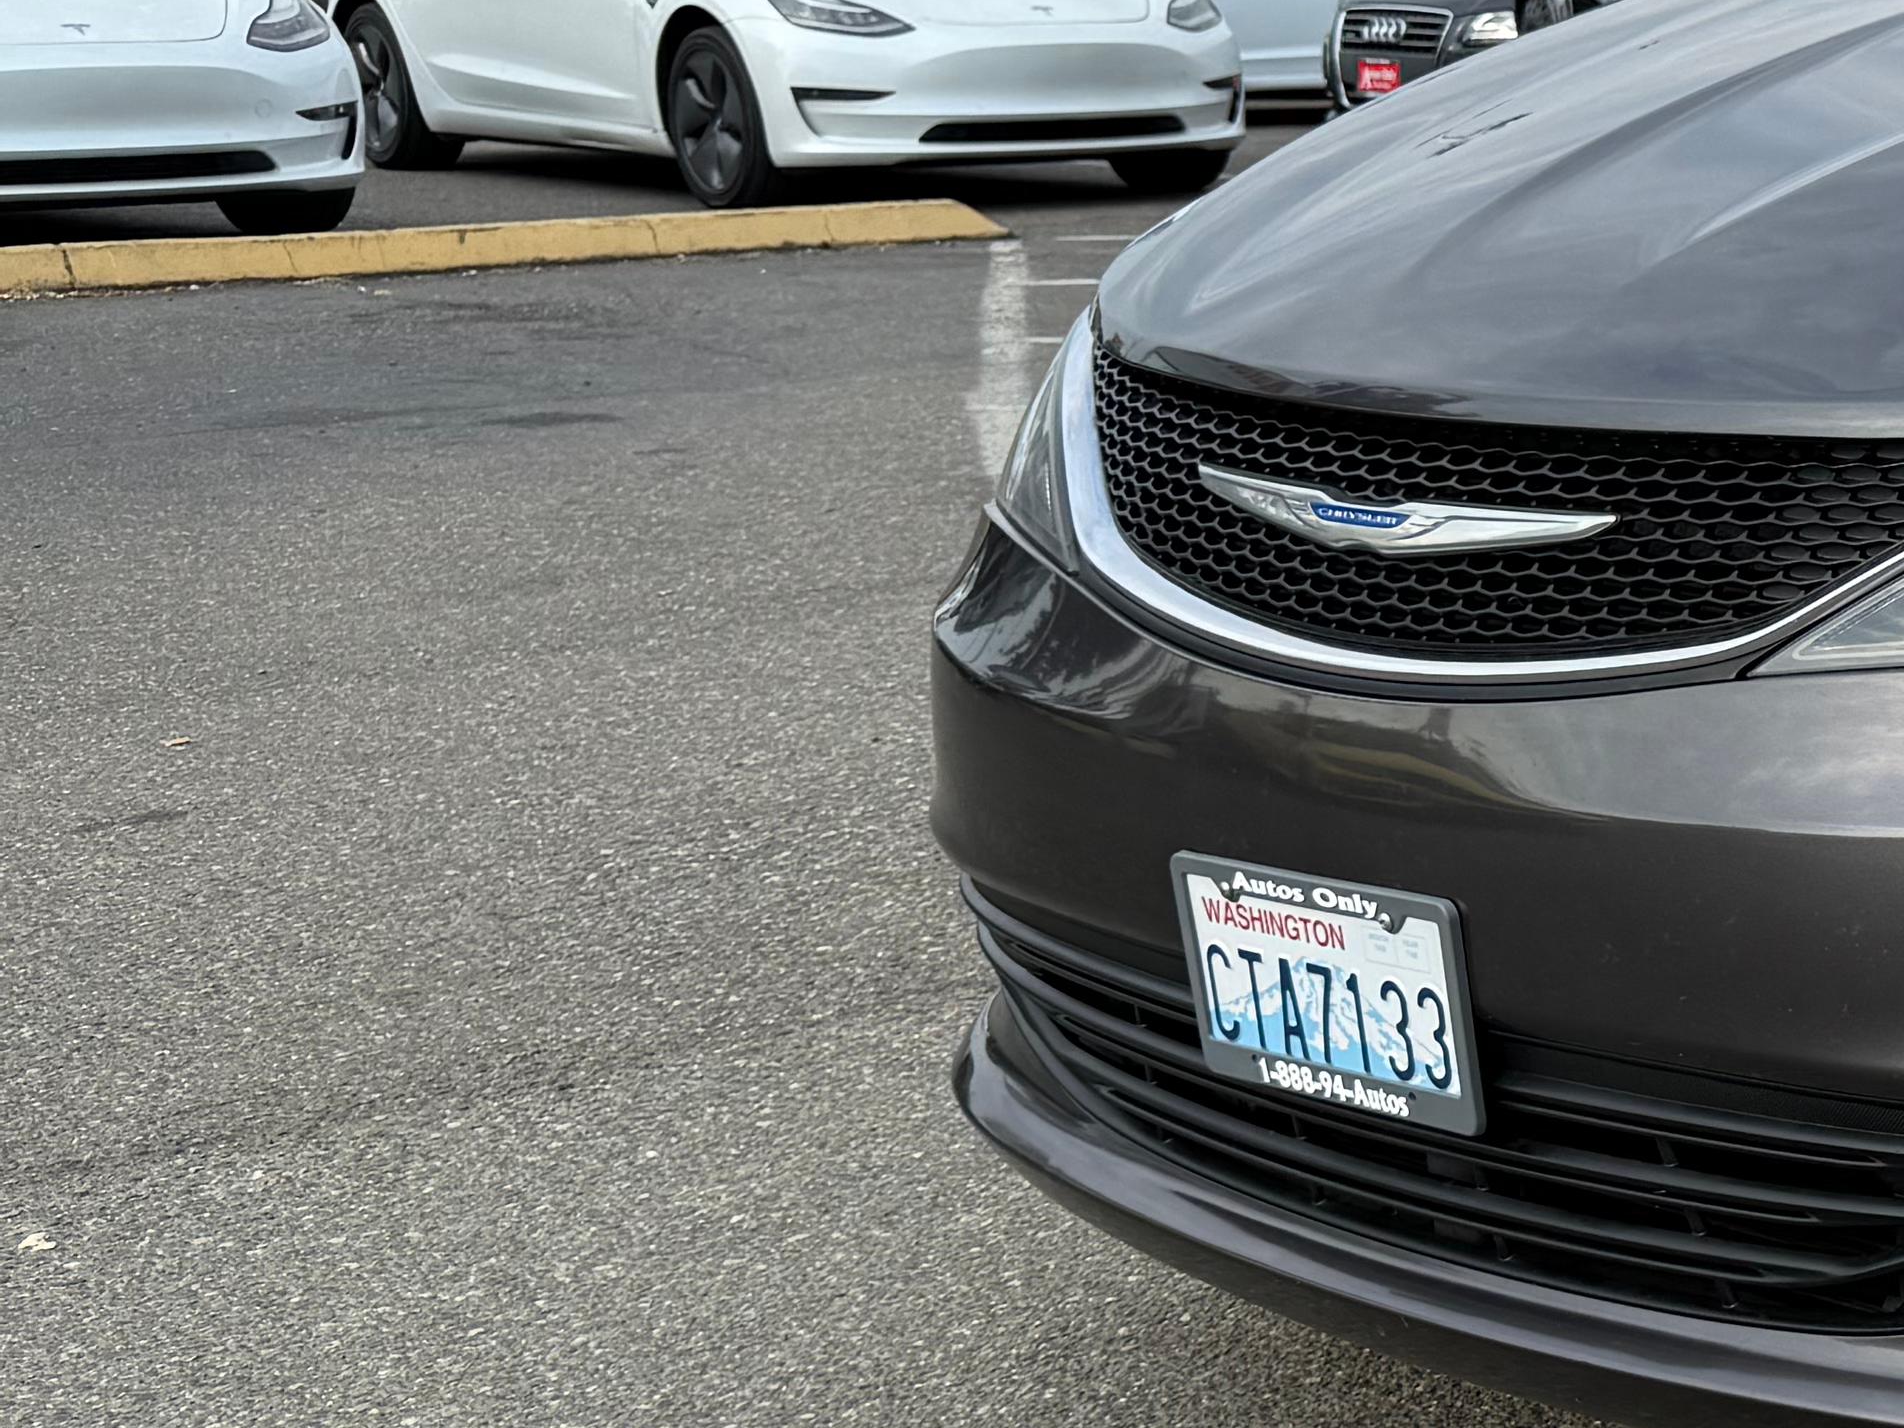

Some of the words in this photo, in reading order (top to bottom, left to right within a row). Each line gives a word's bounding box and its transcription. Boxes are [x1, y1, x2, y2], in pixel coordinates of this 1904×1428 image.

[1201, 895, 1346, 950] WASHINGTON
[1232, 871, 1305, 902] Autos
[1311, 887, 1379, 920] Only
[1206, 943, 1452, 1090] CTA7133
[1258, 1057, 1410, 1117] 1-888-94-Autos
